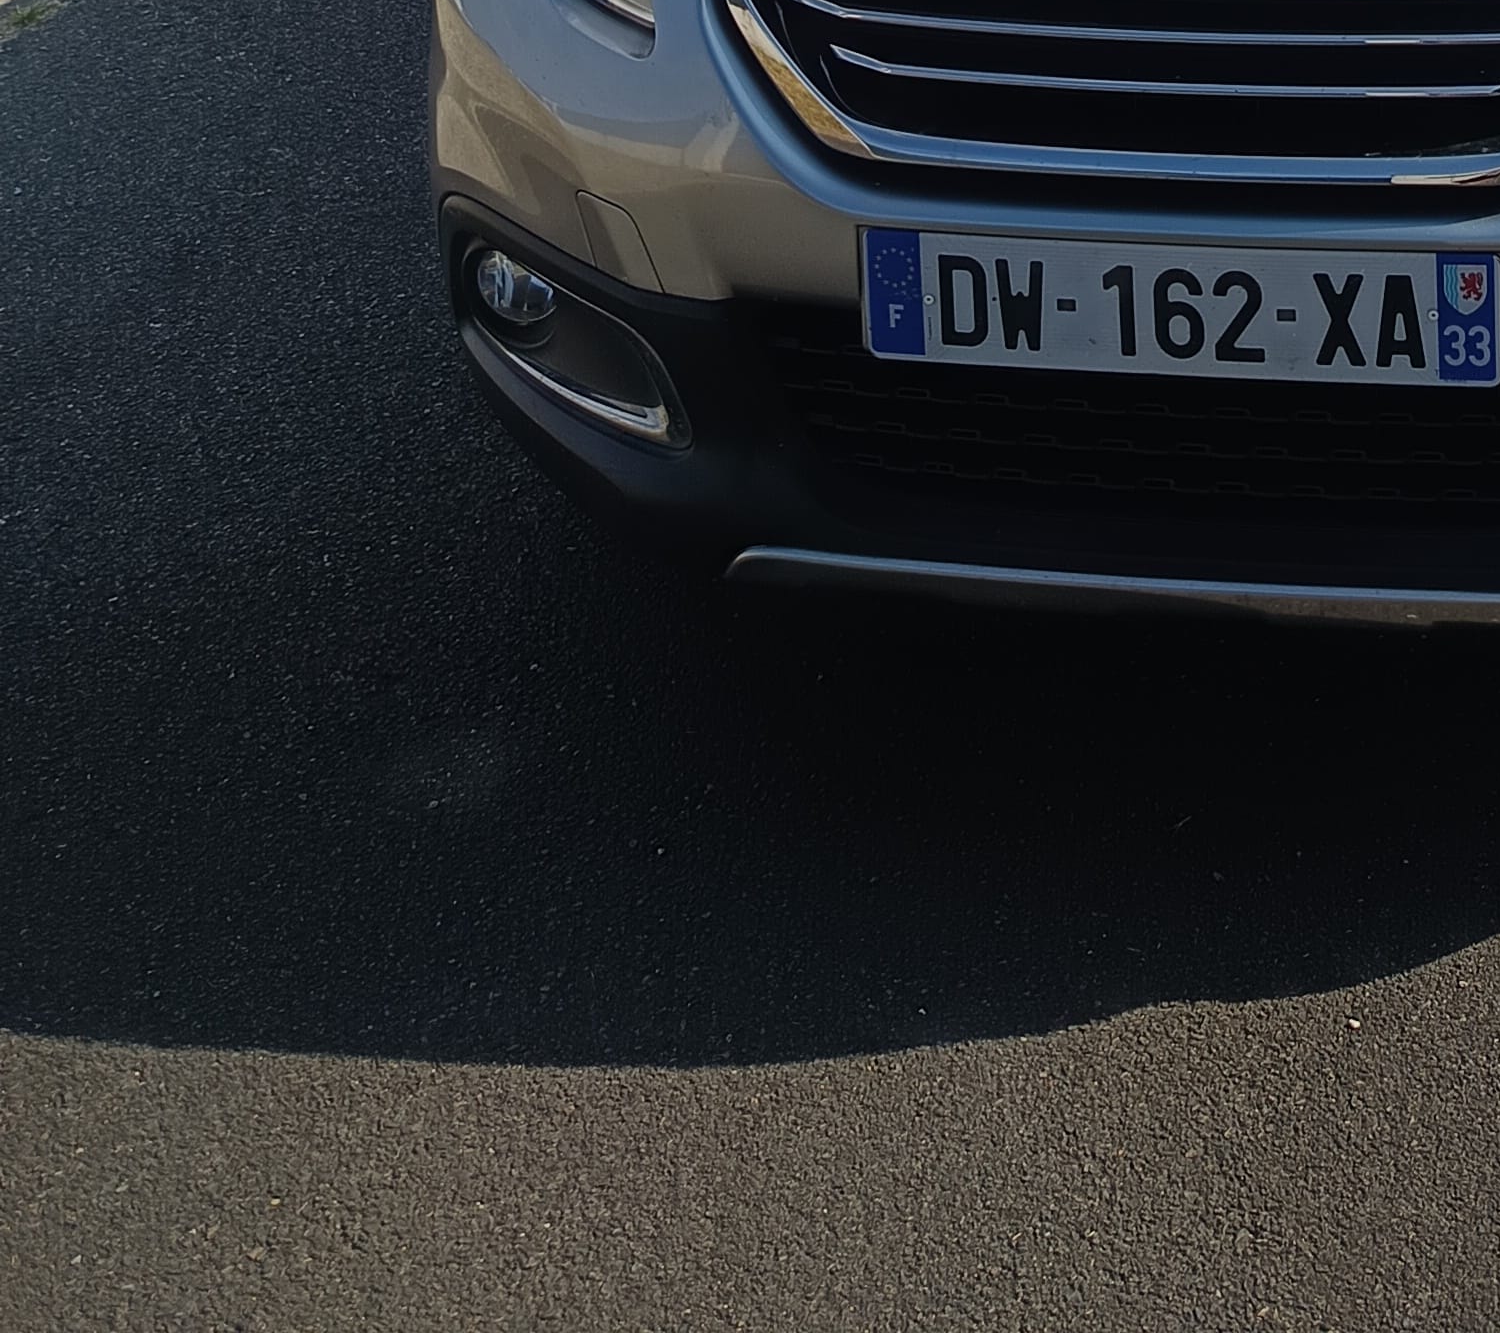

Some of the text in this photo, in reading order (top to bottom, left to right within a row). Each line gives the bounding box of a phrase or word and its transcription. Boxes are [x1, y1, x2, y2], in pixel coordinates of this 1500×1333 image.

[888, 303, 904, 328] F
[937, 254, 1426, 369] DW-162-XA
[1443, 324, 1491, 367] 33
